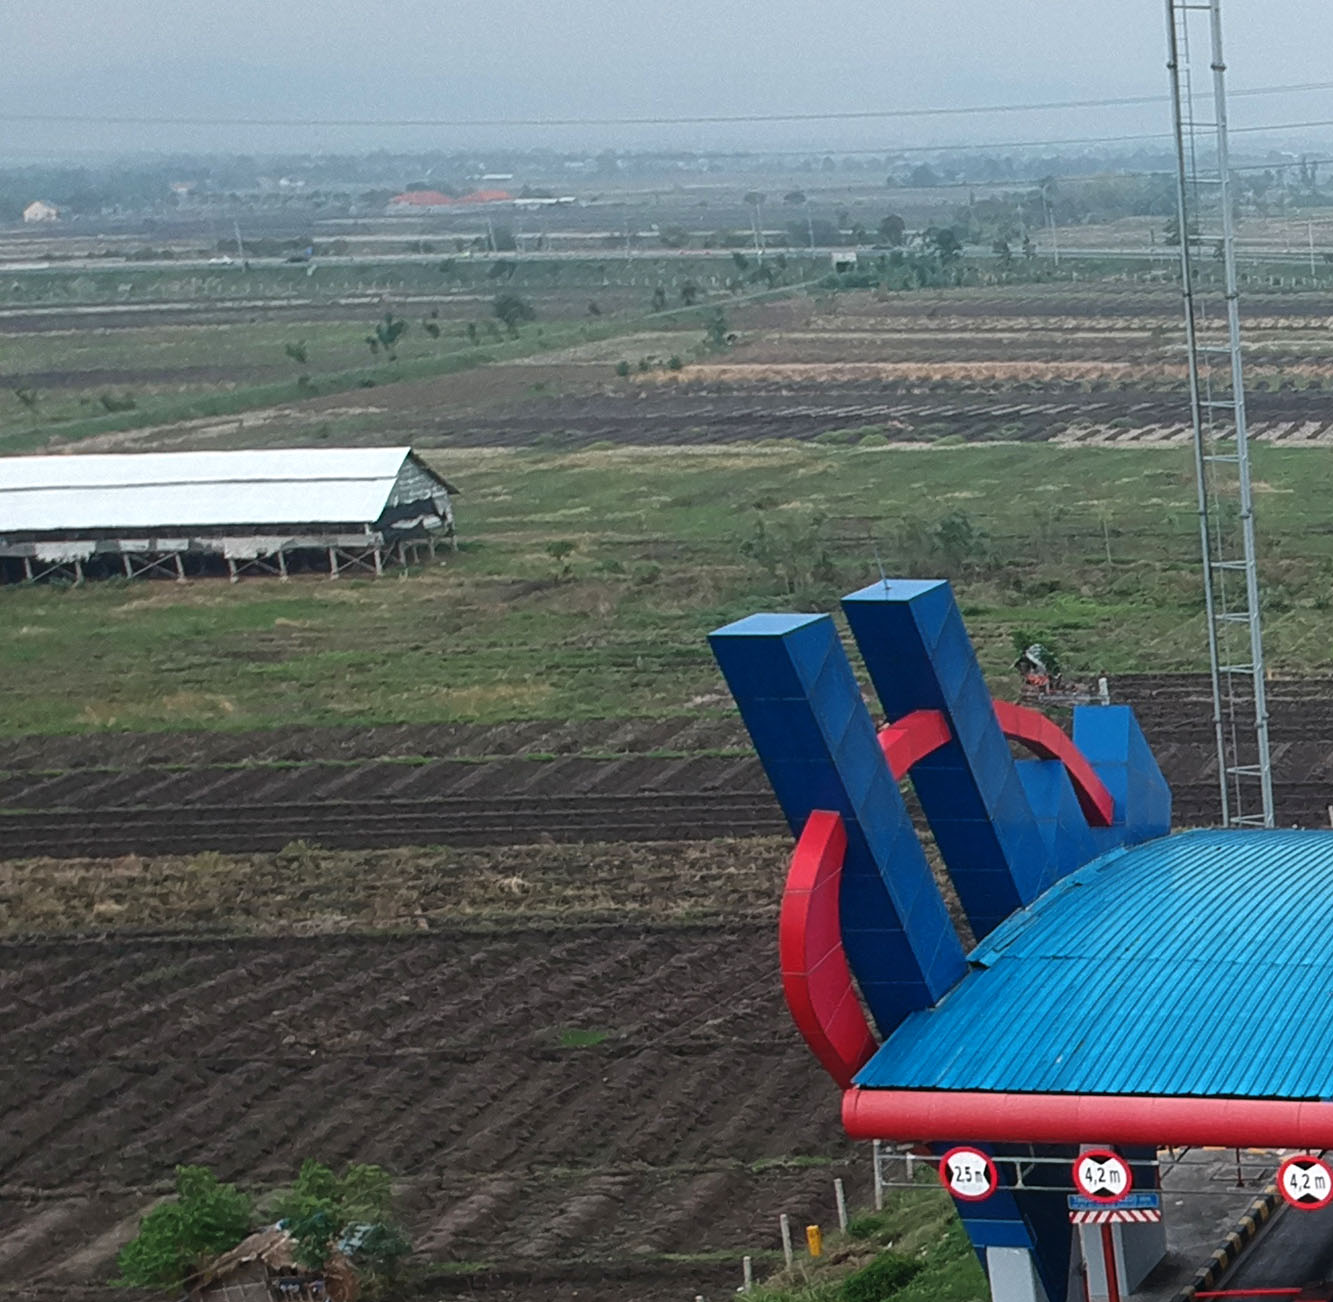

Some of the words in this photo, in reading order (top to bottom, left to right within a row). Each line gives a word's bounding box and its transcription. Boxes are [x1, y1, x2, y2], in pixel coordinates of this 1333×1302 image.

[1085, 1167, 1107, 1186] 4,2
[1109, 1170, 1121, 1184] m
[1290, 1173, 1311, 1192] 4,2
[1315, 1177, 1326, 1190] m
